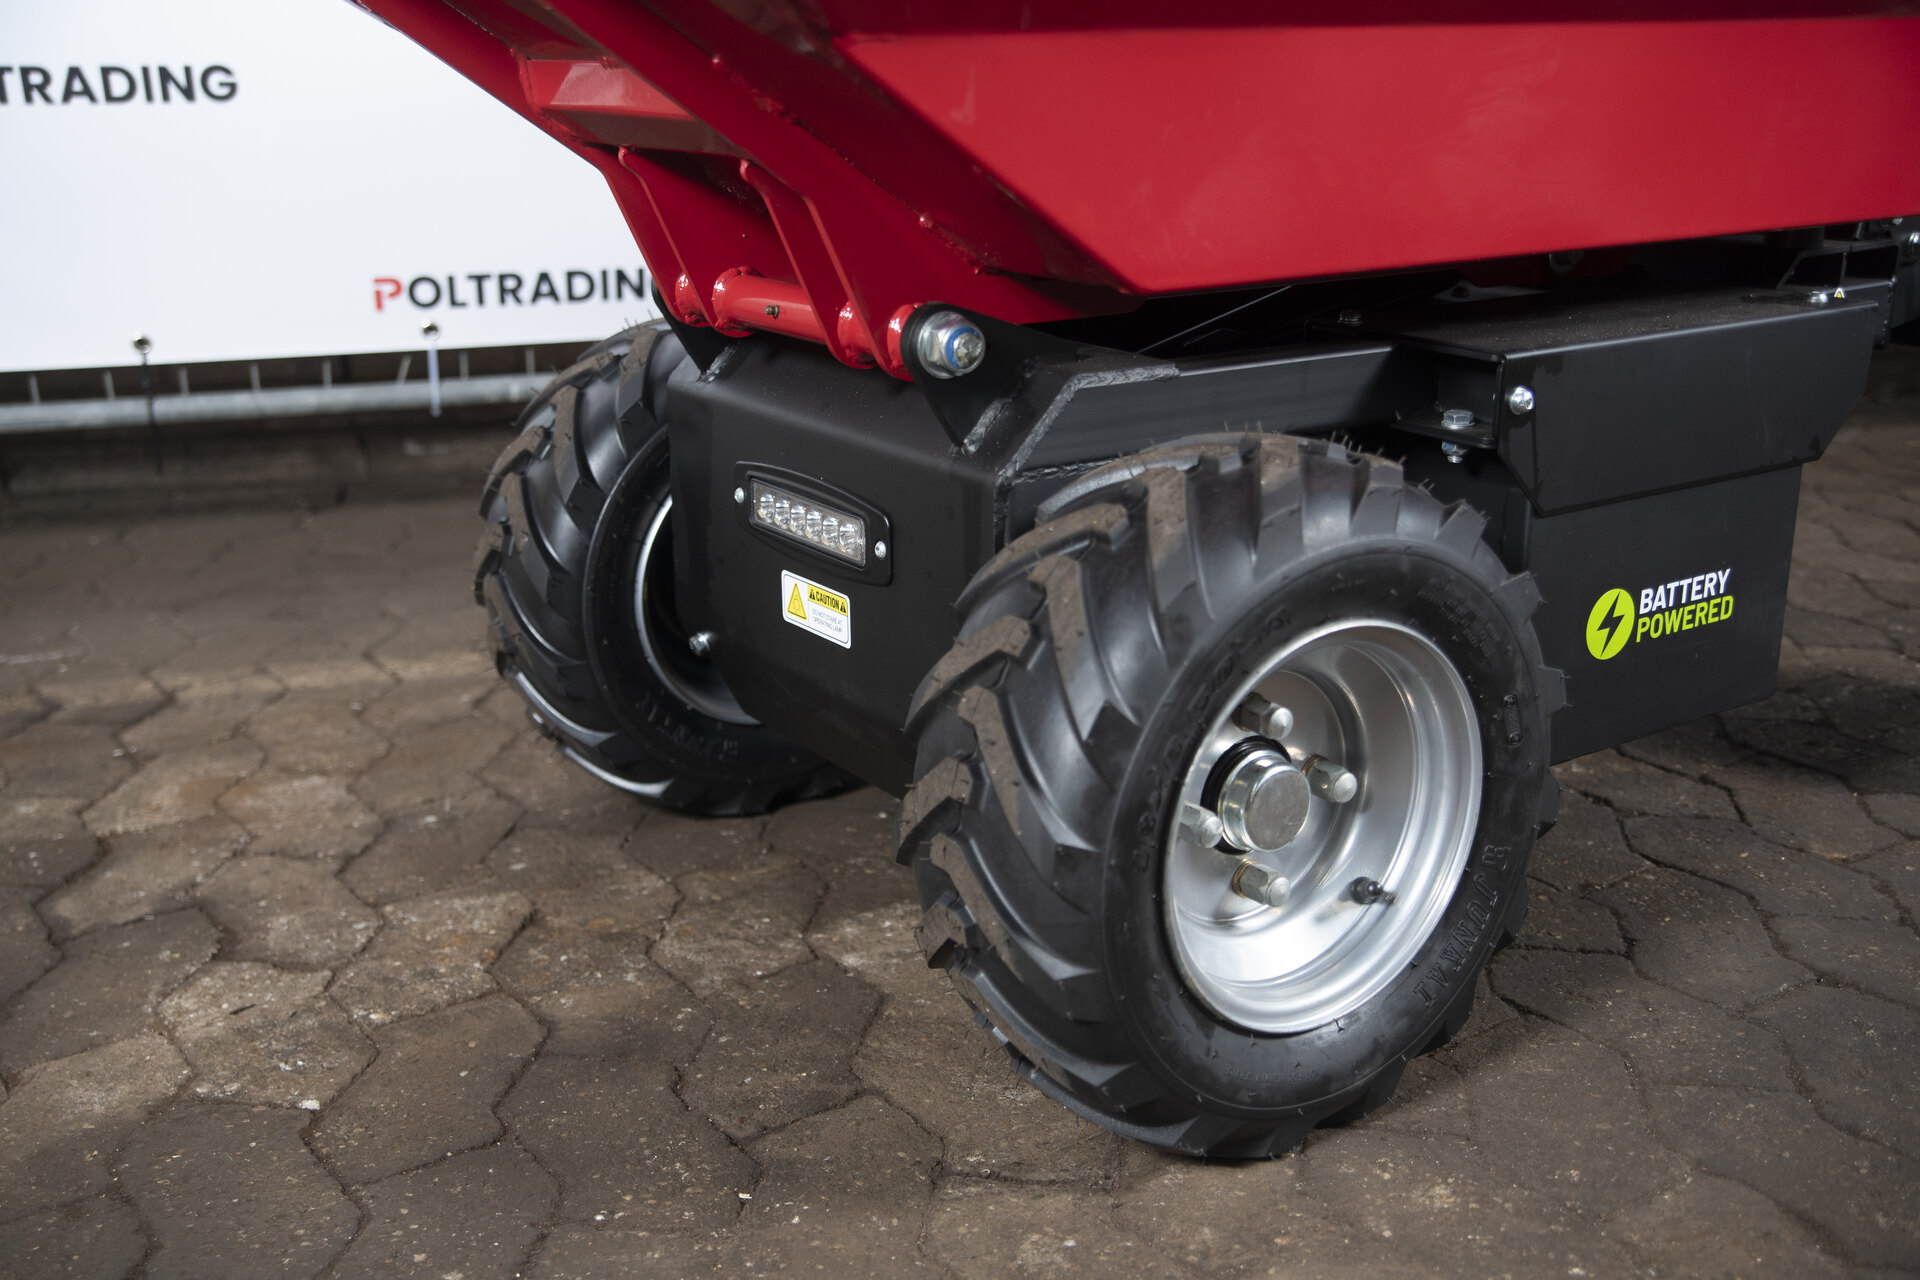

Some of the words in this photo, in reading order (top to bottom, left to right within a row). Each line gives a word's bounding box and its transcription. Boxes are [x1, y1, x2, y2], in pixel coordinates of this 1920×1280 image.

[0, 64, 239, 104] TRADING
[374, 268, 646, 312] POLTRADIN
[816, 591, 839, 610] CAUTION
[1639, 567, 1732, 615] BATTERY
[1636, 595, 1734, 643] POWERED
